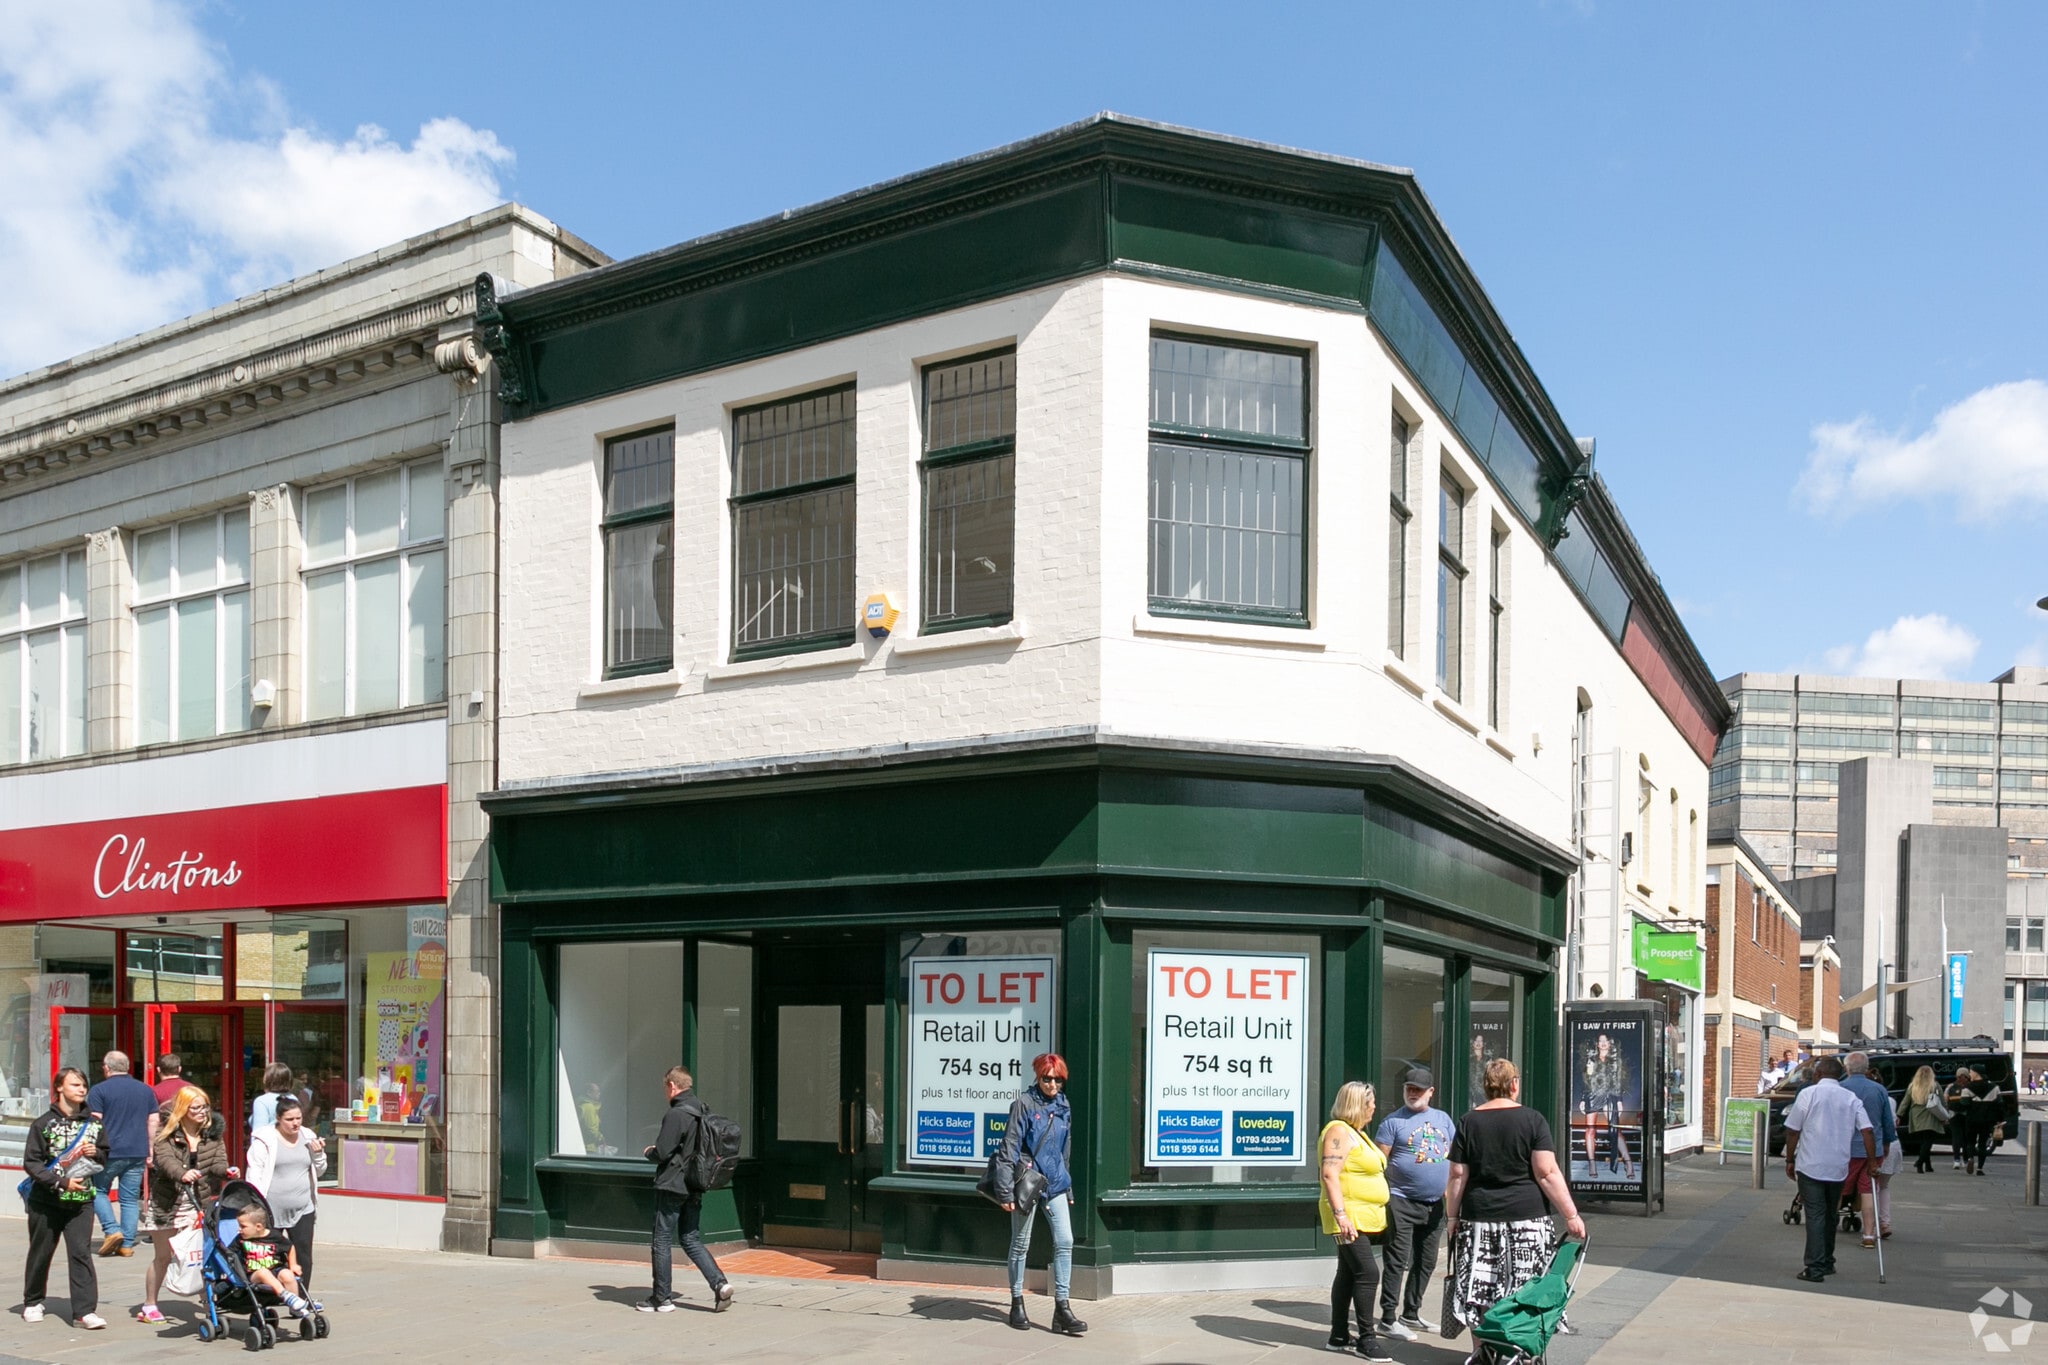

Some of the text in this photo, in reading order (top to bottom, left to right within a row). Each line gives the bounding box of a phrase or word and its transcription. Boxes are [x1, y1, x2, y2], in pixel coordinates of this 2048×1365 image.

[94, 834, 242, 899] Clintons
[1650, 948, 1694, 959] Prospect
[1160, 966, 1297, 1000] TO LET
[1951, 961, 1963, 998] parade
[47, 979, 71, 999] NEW
[381, 985, 428, 995] STATIONERY
[919, 972, 1045, 1005] TO LET
[923, 1020, 1041, 1043] Retail Unit
[1165, 1014, 1293, 1040] Retail Unit
[1602, 1022, 1611, 1030] IT
[1613, 1022, 1636, 1030] FIRST
[939, 1058, 1022, 1080] 754 sq ft
[1183, 1055, 1273, 1078] 754 sq ft
[921, 1087, 1022, 1100] plus 1st floor ancill
[1162, 1085, 1290, 1100] plus 1st floor ancillary
[919, 1116, 973, 1128] Hicks Baker
[990, 1119, 1007, 1131] lov
[1160, 1115, 1221, 1127] Hicks Baker
[1239, 1116, 1287, 1132] loveday
[1236, 1135, 1290, 1144] 01793 423344
[364, 1143, 396, 1167] 3 2
[919, 1144, 972, 1154] 0118 959 6144
[1160, 1145, 1219, 1154] 0118 959 6144
